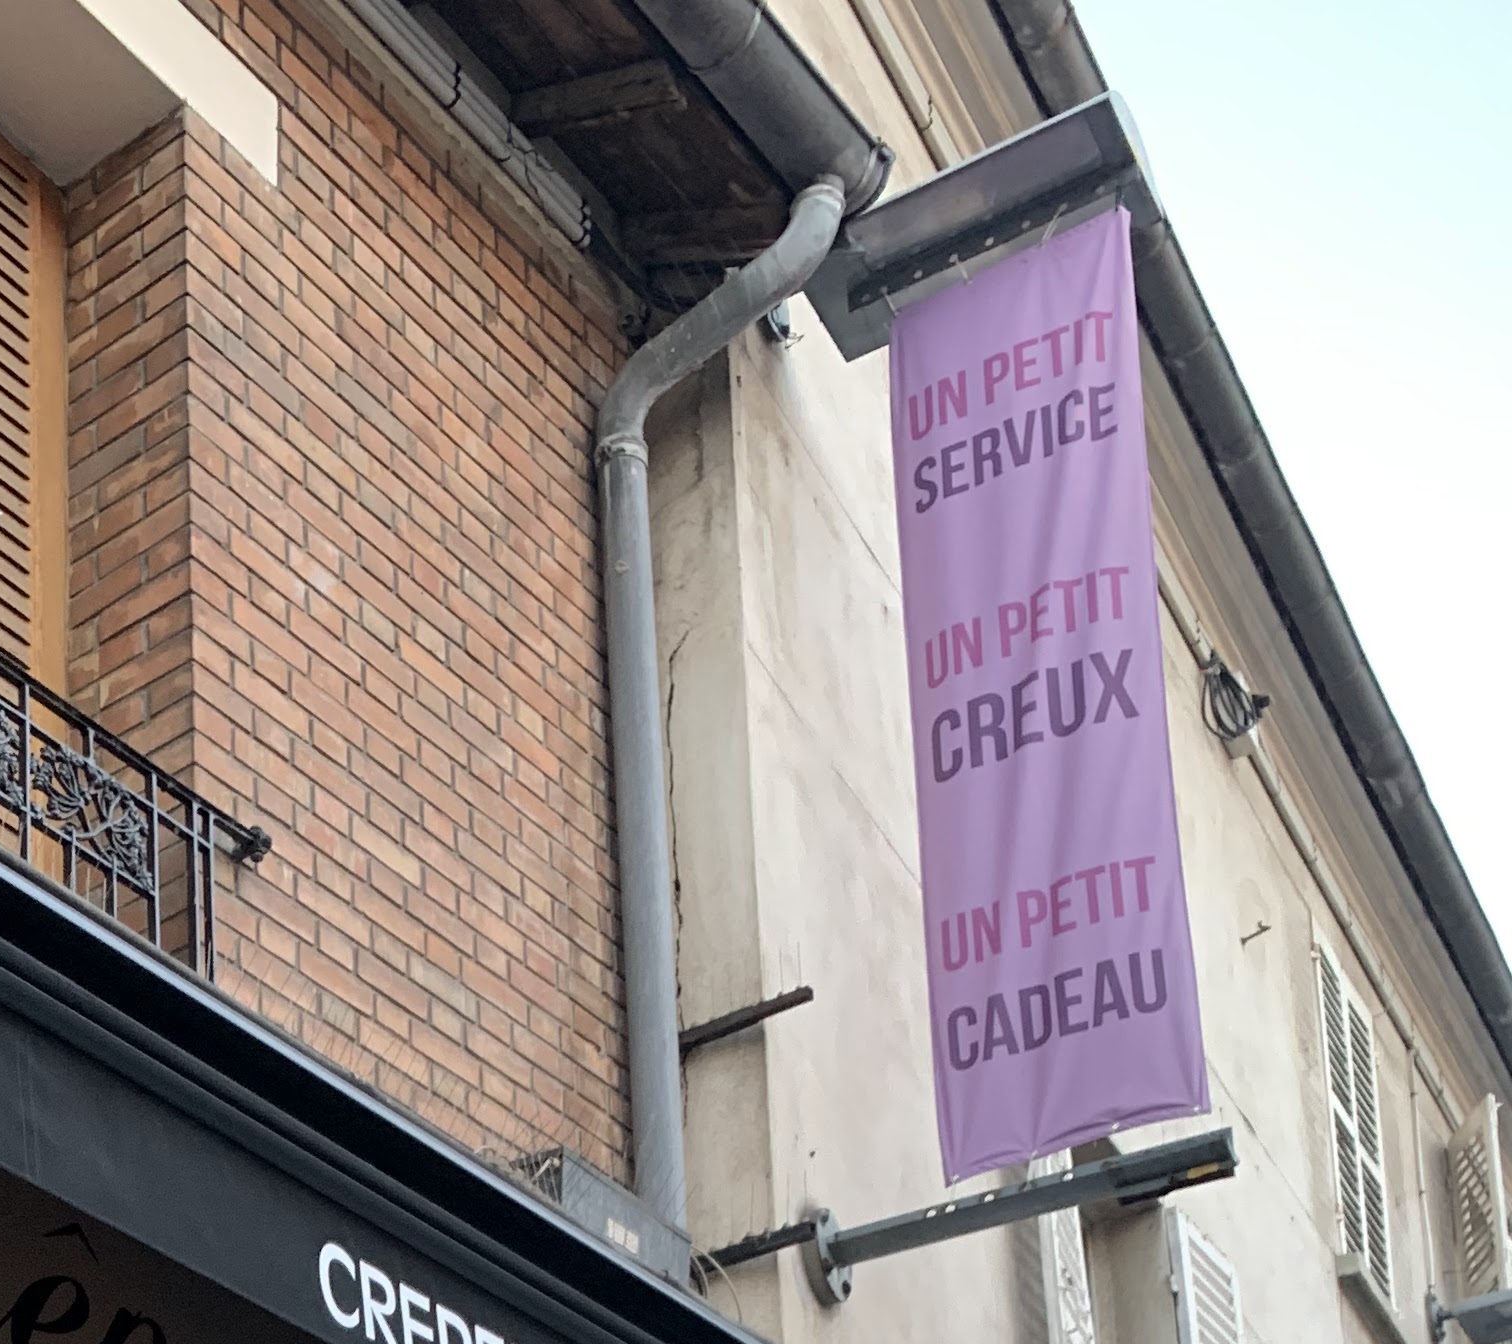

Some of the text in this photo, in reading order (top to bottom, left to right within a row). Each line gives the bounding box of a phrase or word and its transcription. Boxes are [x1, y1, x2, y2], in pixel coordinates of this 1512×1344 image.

[907, 311, 1115, 442] UN PETIT
[913, 383, 1119, 514] SERVICE
[924, 566, 1131, 691] UN PETIT
[931, 648, 1141, 784] CREUX
[939, 856, 1156, 973] UN PETIT
[946, 948, 1169, 1070] CADEAU
